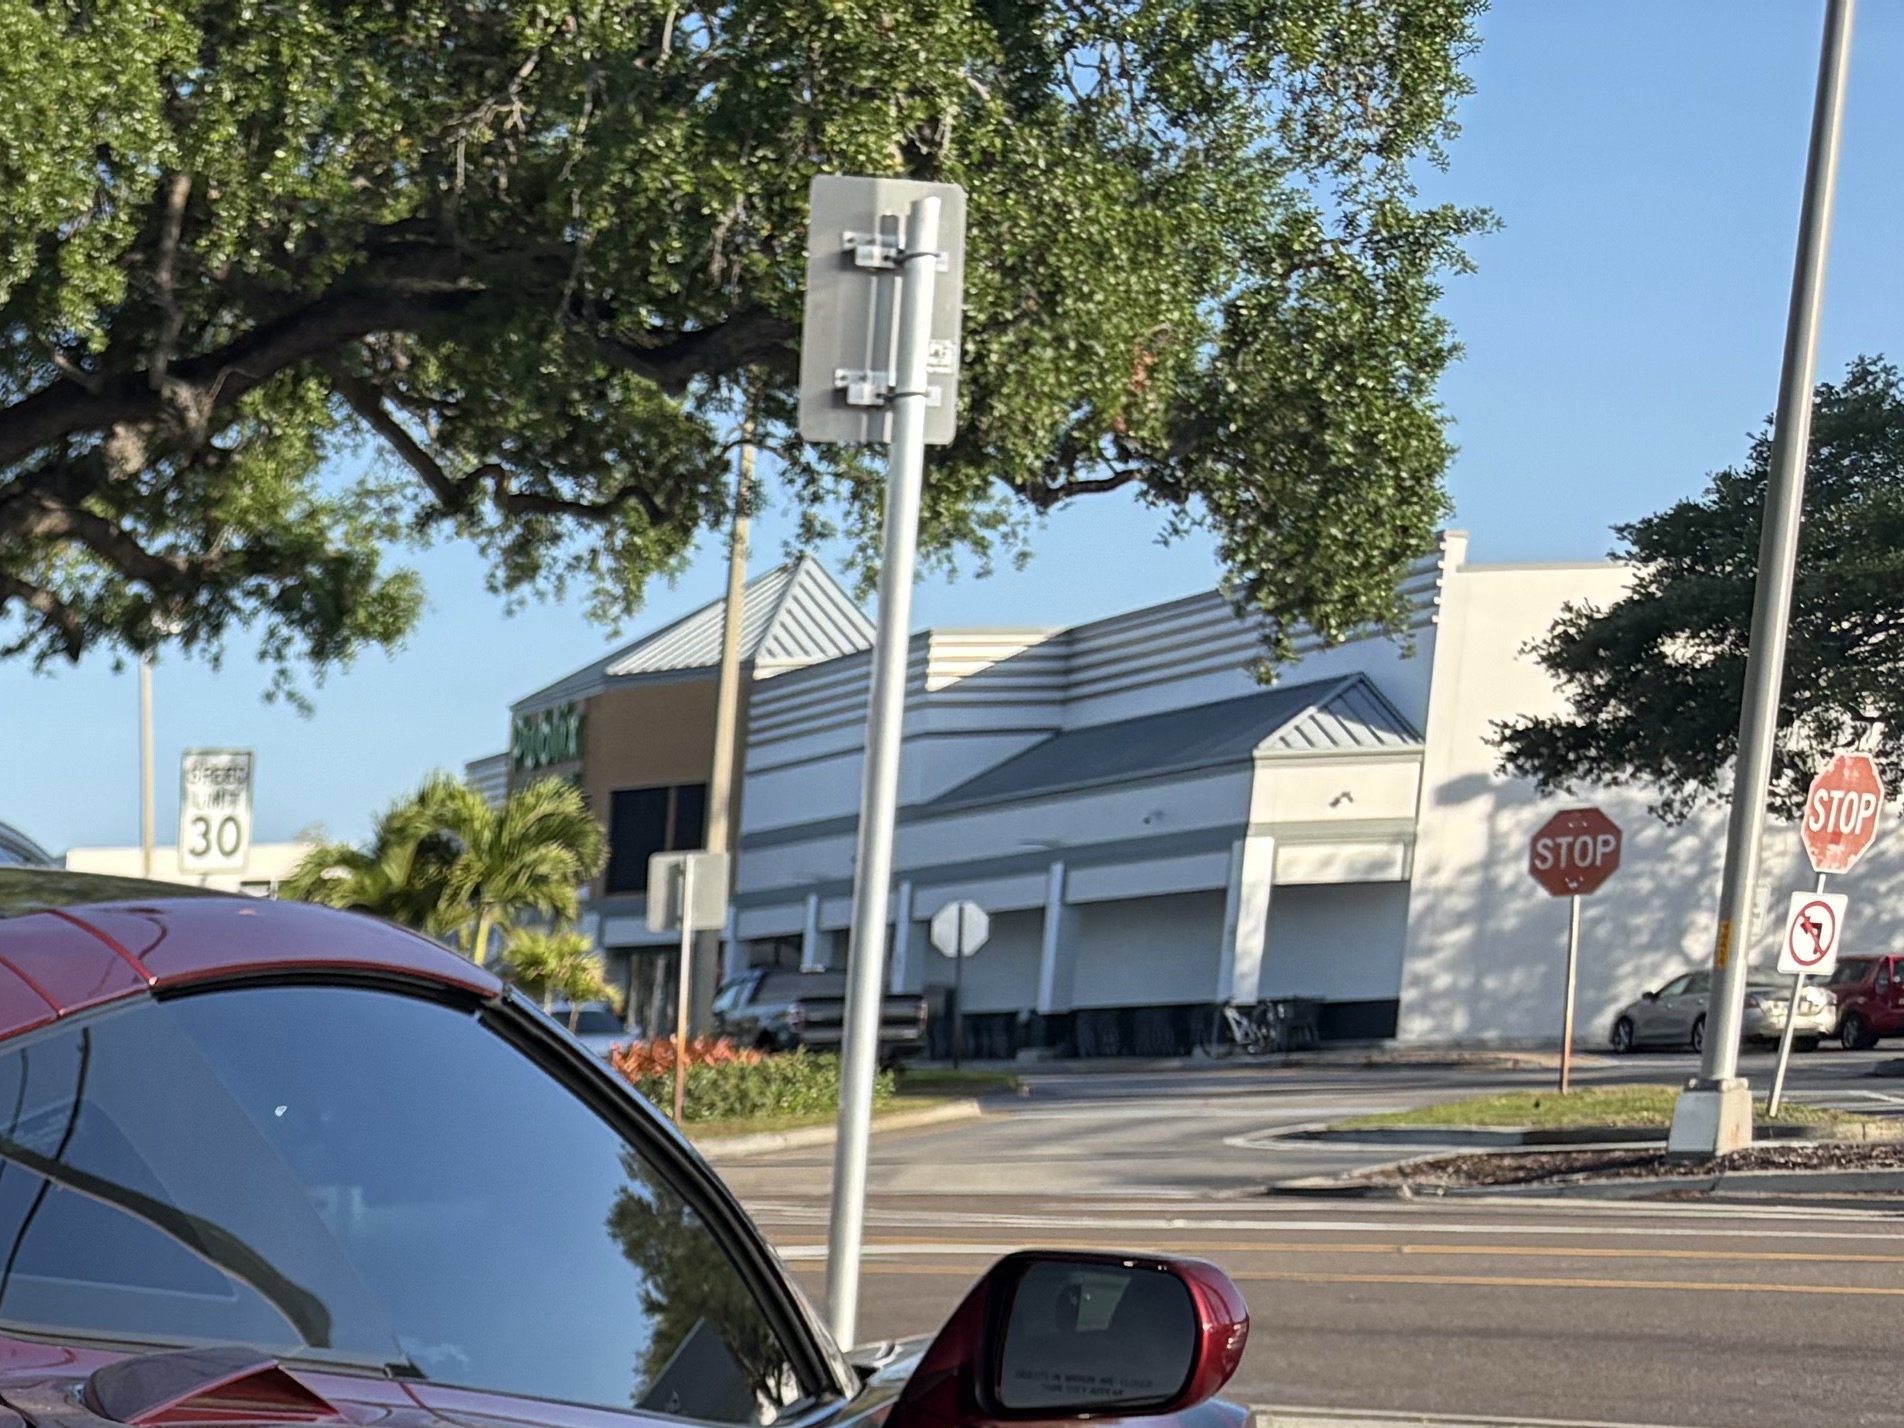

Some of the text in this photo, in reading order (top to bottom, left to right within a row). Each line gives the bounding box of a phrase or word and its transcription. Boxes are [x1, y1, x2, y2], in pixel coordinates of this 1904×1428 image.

[1808, 788, 1877, 836] STOP
[189, 815, 242, 857] 30
[1534, 833, 1617, 870] STOP
